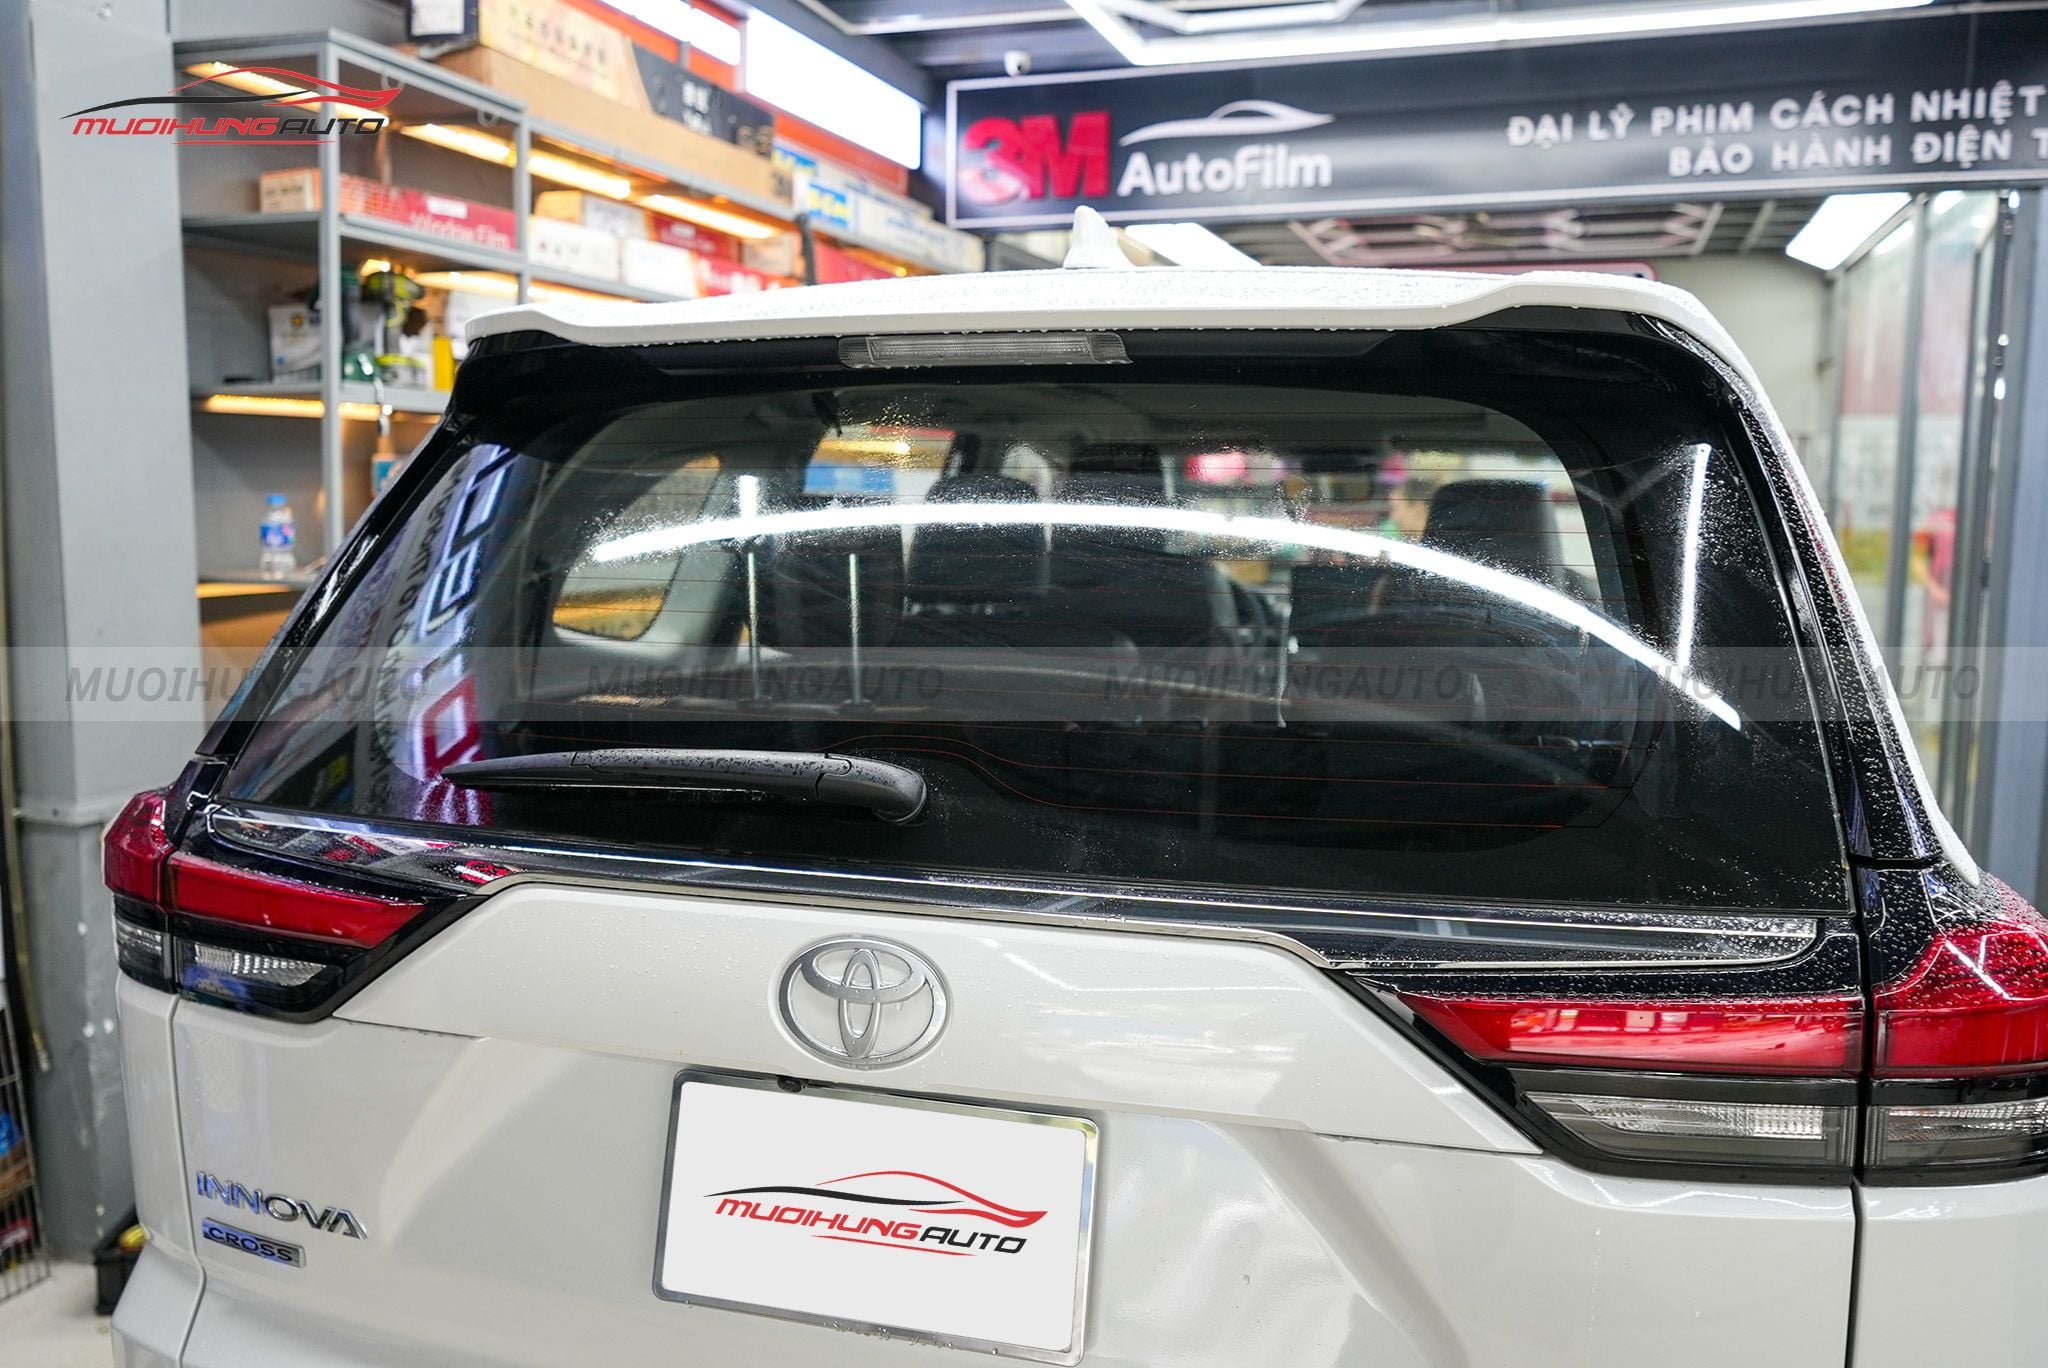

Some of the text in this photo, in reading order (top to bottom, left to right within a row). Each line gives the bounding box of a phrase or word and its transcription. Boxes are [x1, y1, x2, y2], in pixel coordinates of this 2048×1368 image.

[1506, 113, 1573, 150] ĐẠI
[1650, 101, 1755, 138] PHIM
[1769, 90, 1894, 130] CÁCH
[1910, 79, 2047, 126] NHIỆT
[960, 110, 1110, 205] 3M
[1116, 142, 1332, 197] AutoFilm
[1668, 139, 1753, 178] BẢO
[1770, 130, 1892, 172] HÀNH
[1911, 123, 2013, 169] ĐIỆN
[196, 1170, 367, 1240] INNOVA
[208, 1226, 293, 1262] CROSS
